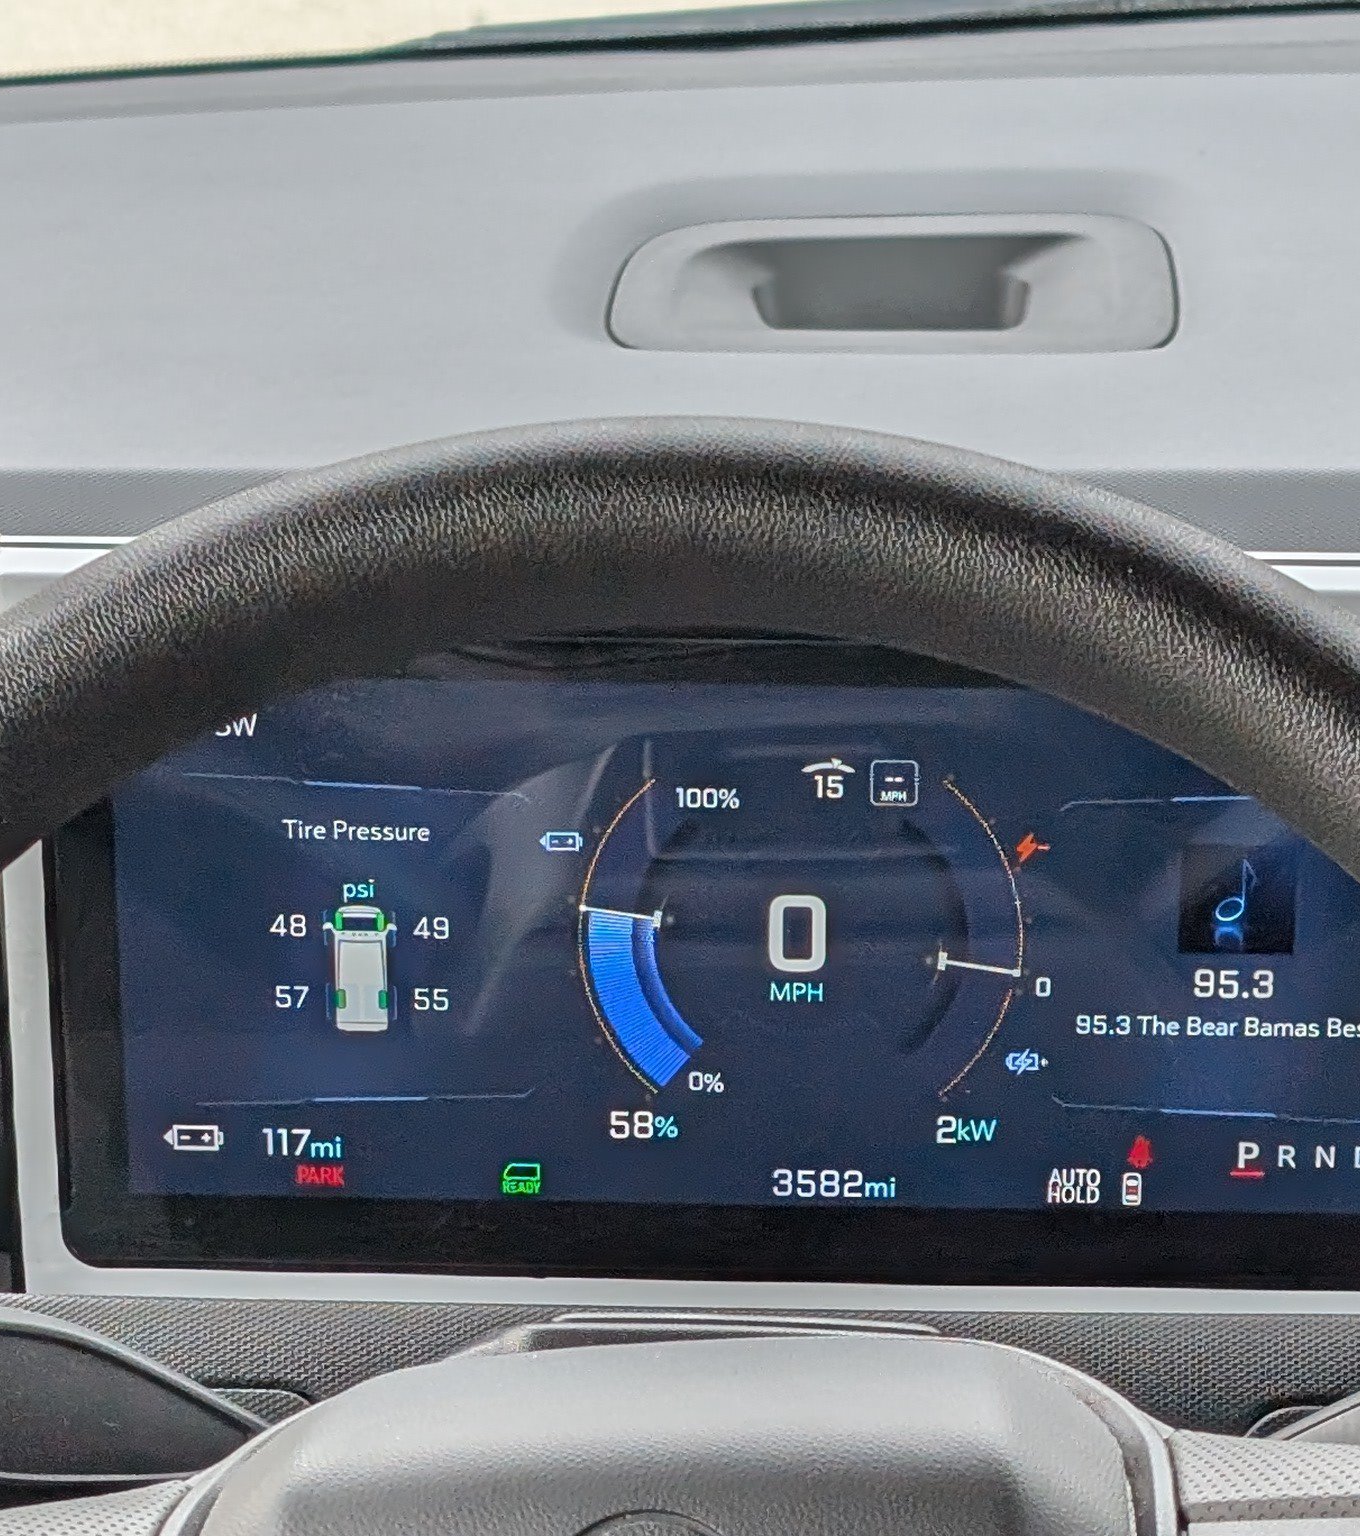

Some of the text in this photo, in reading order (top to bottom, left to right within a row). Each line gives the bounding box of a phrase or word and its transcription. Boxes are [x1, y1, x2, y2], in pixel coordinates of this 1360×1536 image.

[675, 787, 740, 809] 100%
[814, 774, 844, 799] 15
[880, 790, 907, 802] MPH
[281, 818, 431, 842] Tire Pressure
[342, 878, 375, 902] psi
[269, 913, 307, 937] 48
[412, 916, 450, 940] 49
[768, 894, 827, 973] 0
[769, 982, 824, 1003] MPH
[1035, 976, 1052, 997] 0
[1193, 968, 1274, 999] 95.3
[275, 985, 310, 1009] 57
[413, 987, 449, 1011] 55
[1075, 1014, 1131, 1035] 95.3
[1136, 1014, 1181, 1036] The
[1186, 1016, 1239, 1037] Bear
[1244, 1016, 1320, 1038] Bamas
[688, 1071, 725, 1093] 0%
[609, 1110, 679, 1139] 58%
[936, 1115, 997, 1144] 2kW
[262, 1127, 342, 1159] 117mi
[1237, 1141, 1260, 1169] P
[1277, 1145, 1296, 1169] R
[1315, 1145, 1336, 1169] N
[296, 1164, 345, 1186] PARK
[772, 1168, 896, 1198] 3582mi
[1048, 1168, 1101, 1187] AUTO
[502, 1181, 541, 1194] READY
[1047, 1186, 1100, 1204] HOLD
